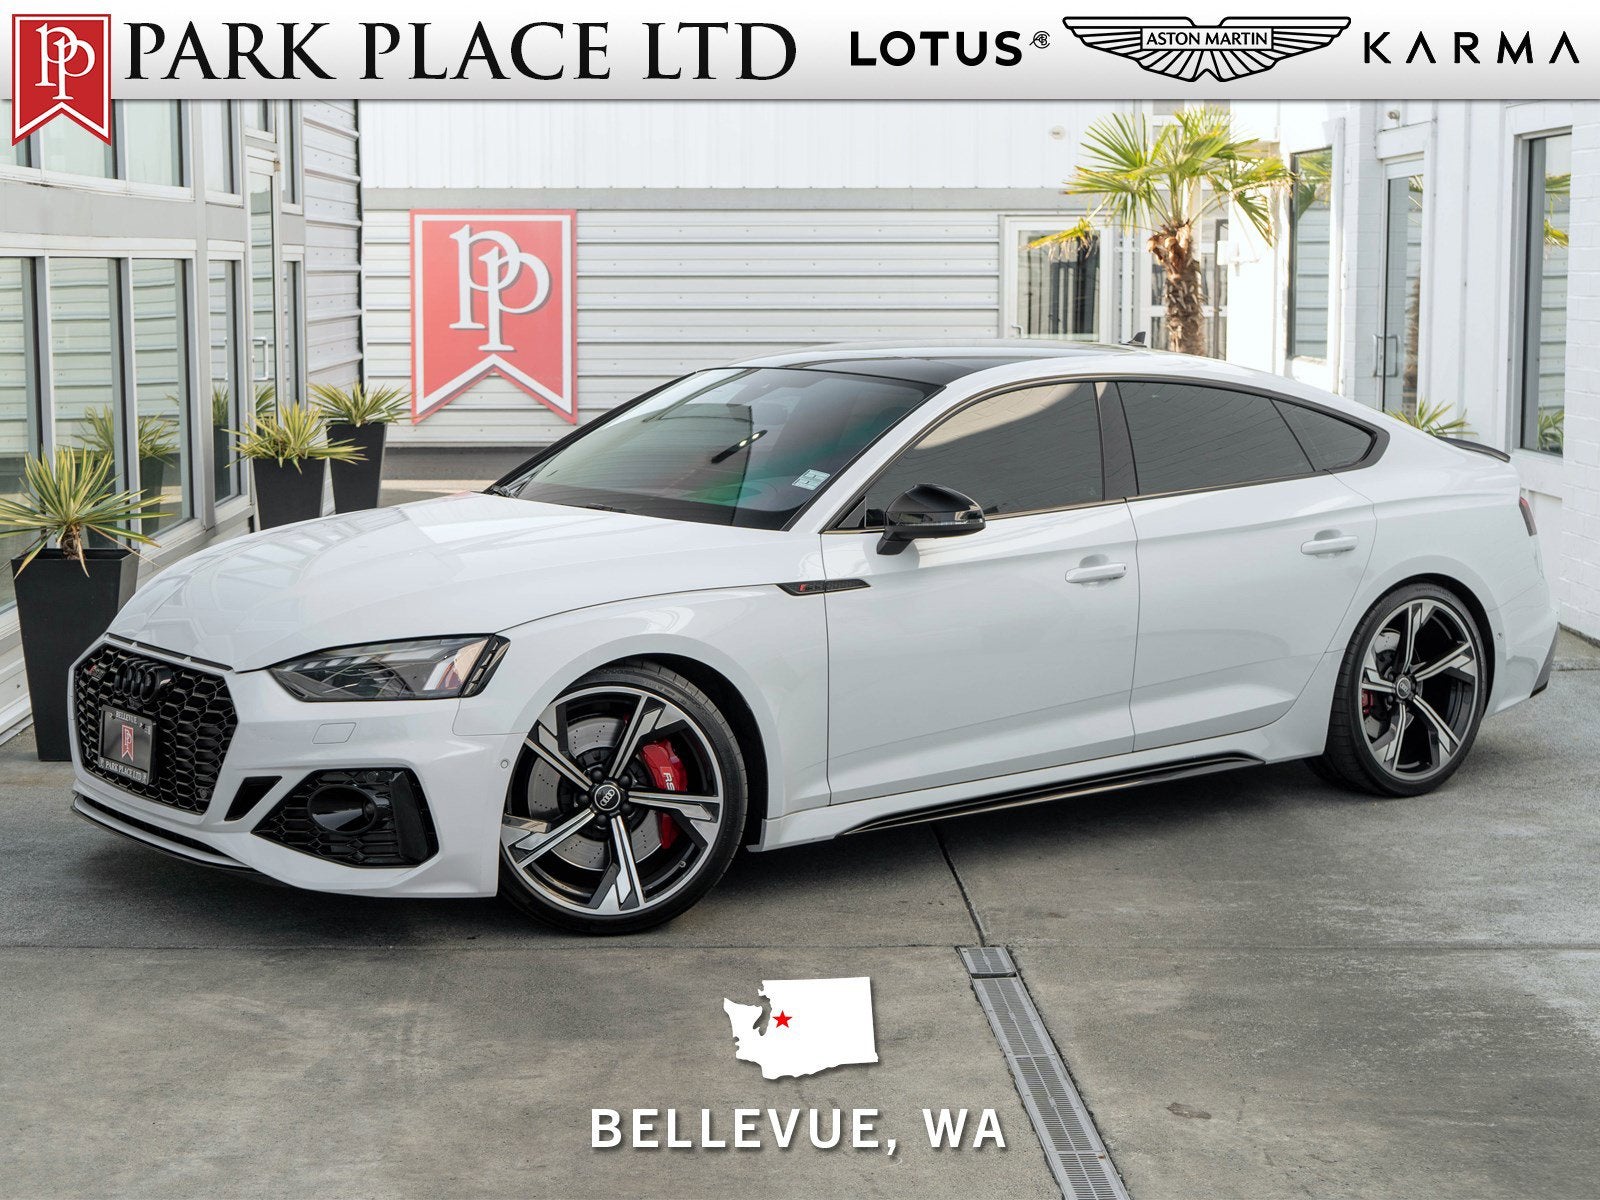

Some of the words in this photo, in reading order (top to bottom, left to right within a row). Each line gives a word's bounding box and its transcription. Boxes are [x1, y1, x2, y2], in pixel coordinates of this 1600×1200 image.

[115, 711, 138, 724] BELLEVUE
[105, 760, 119, 772] PARK
[118, 765, 132, 777] PLACE
[132, 770, 142, 780] LTD
